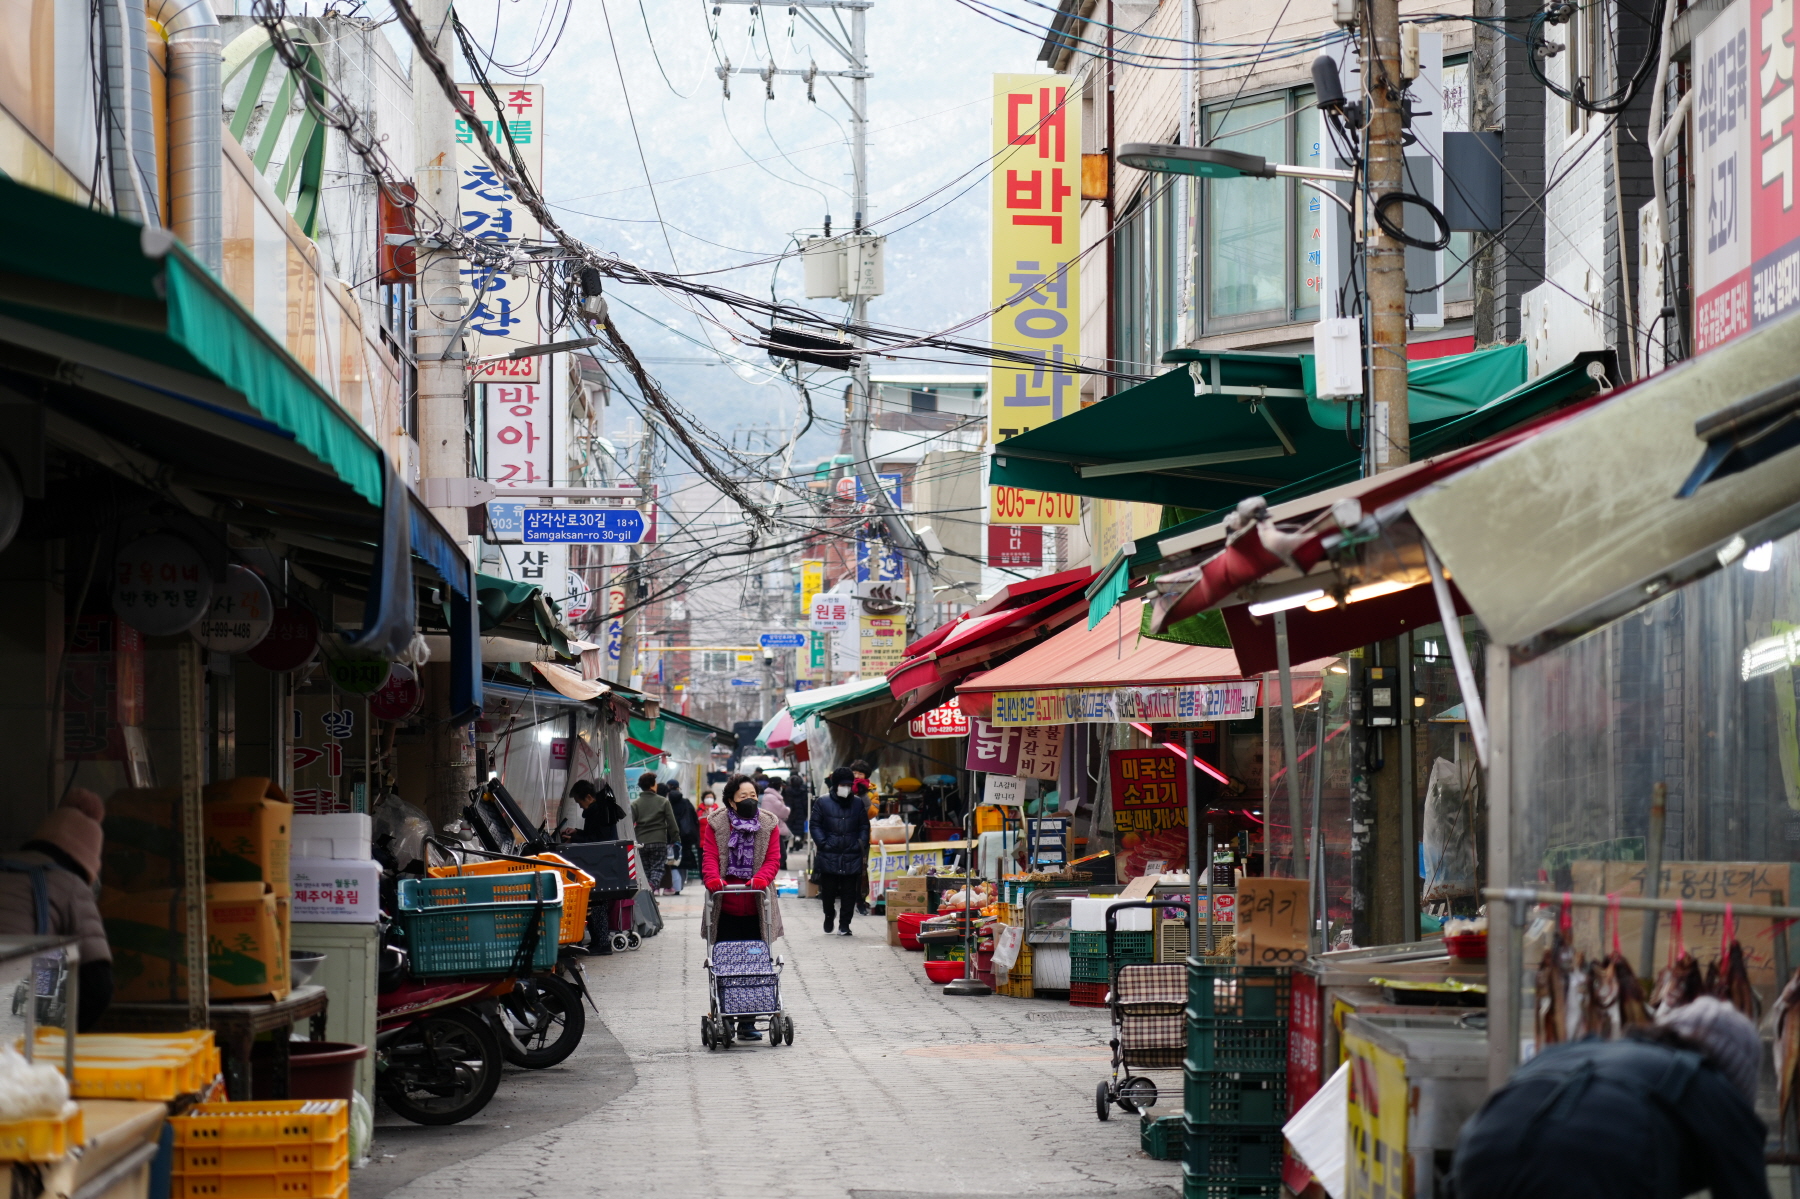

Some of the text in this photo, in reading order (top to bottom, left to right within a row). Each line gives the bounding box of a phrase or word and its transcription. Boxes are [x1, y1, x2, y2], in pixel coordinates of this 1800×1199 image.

[455, 119, 533, 144] 참기름
[1006, 86, 1072, 245] 대박
[1708, 150, 1738, 255] 소고기
[1754, 264, 1776, 322] 국내산
[1005, 260, 1074, 420] 청과
[996, 484, 1075, 519] 905-7510
[492, 518, 523, 535] 903-
[527, 513, 606, 528] 삼각산로30길
[527, 530, 631, 542] Samgaksan-ro 30-gil
[517, 551, 549, 578] 샵
[815, 604, 847, 620] 원룸
[200, 621, 251, 639] 02-999-4486
[336, 665, 380, 684] 야채
[373, 689, 409, 705] 기름집
[926, 708, 966, 726] 건강원
[975, 720, 1019, 764] 닭
[1040, 724, 1062, 778] 불고기
[1121, 756, 1176, 780] 미국산
[993, 781, 1017, 790] LA갈비
[1123, 783, 1179, 806] 소고기
[1115, 807, 1188, 833] 판매개시
[294, 889, 359, 904] 제주어울림
